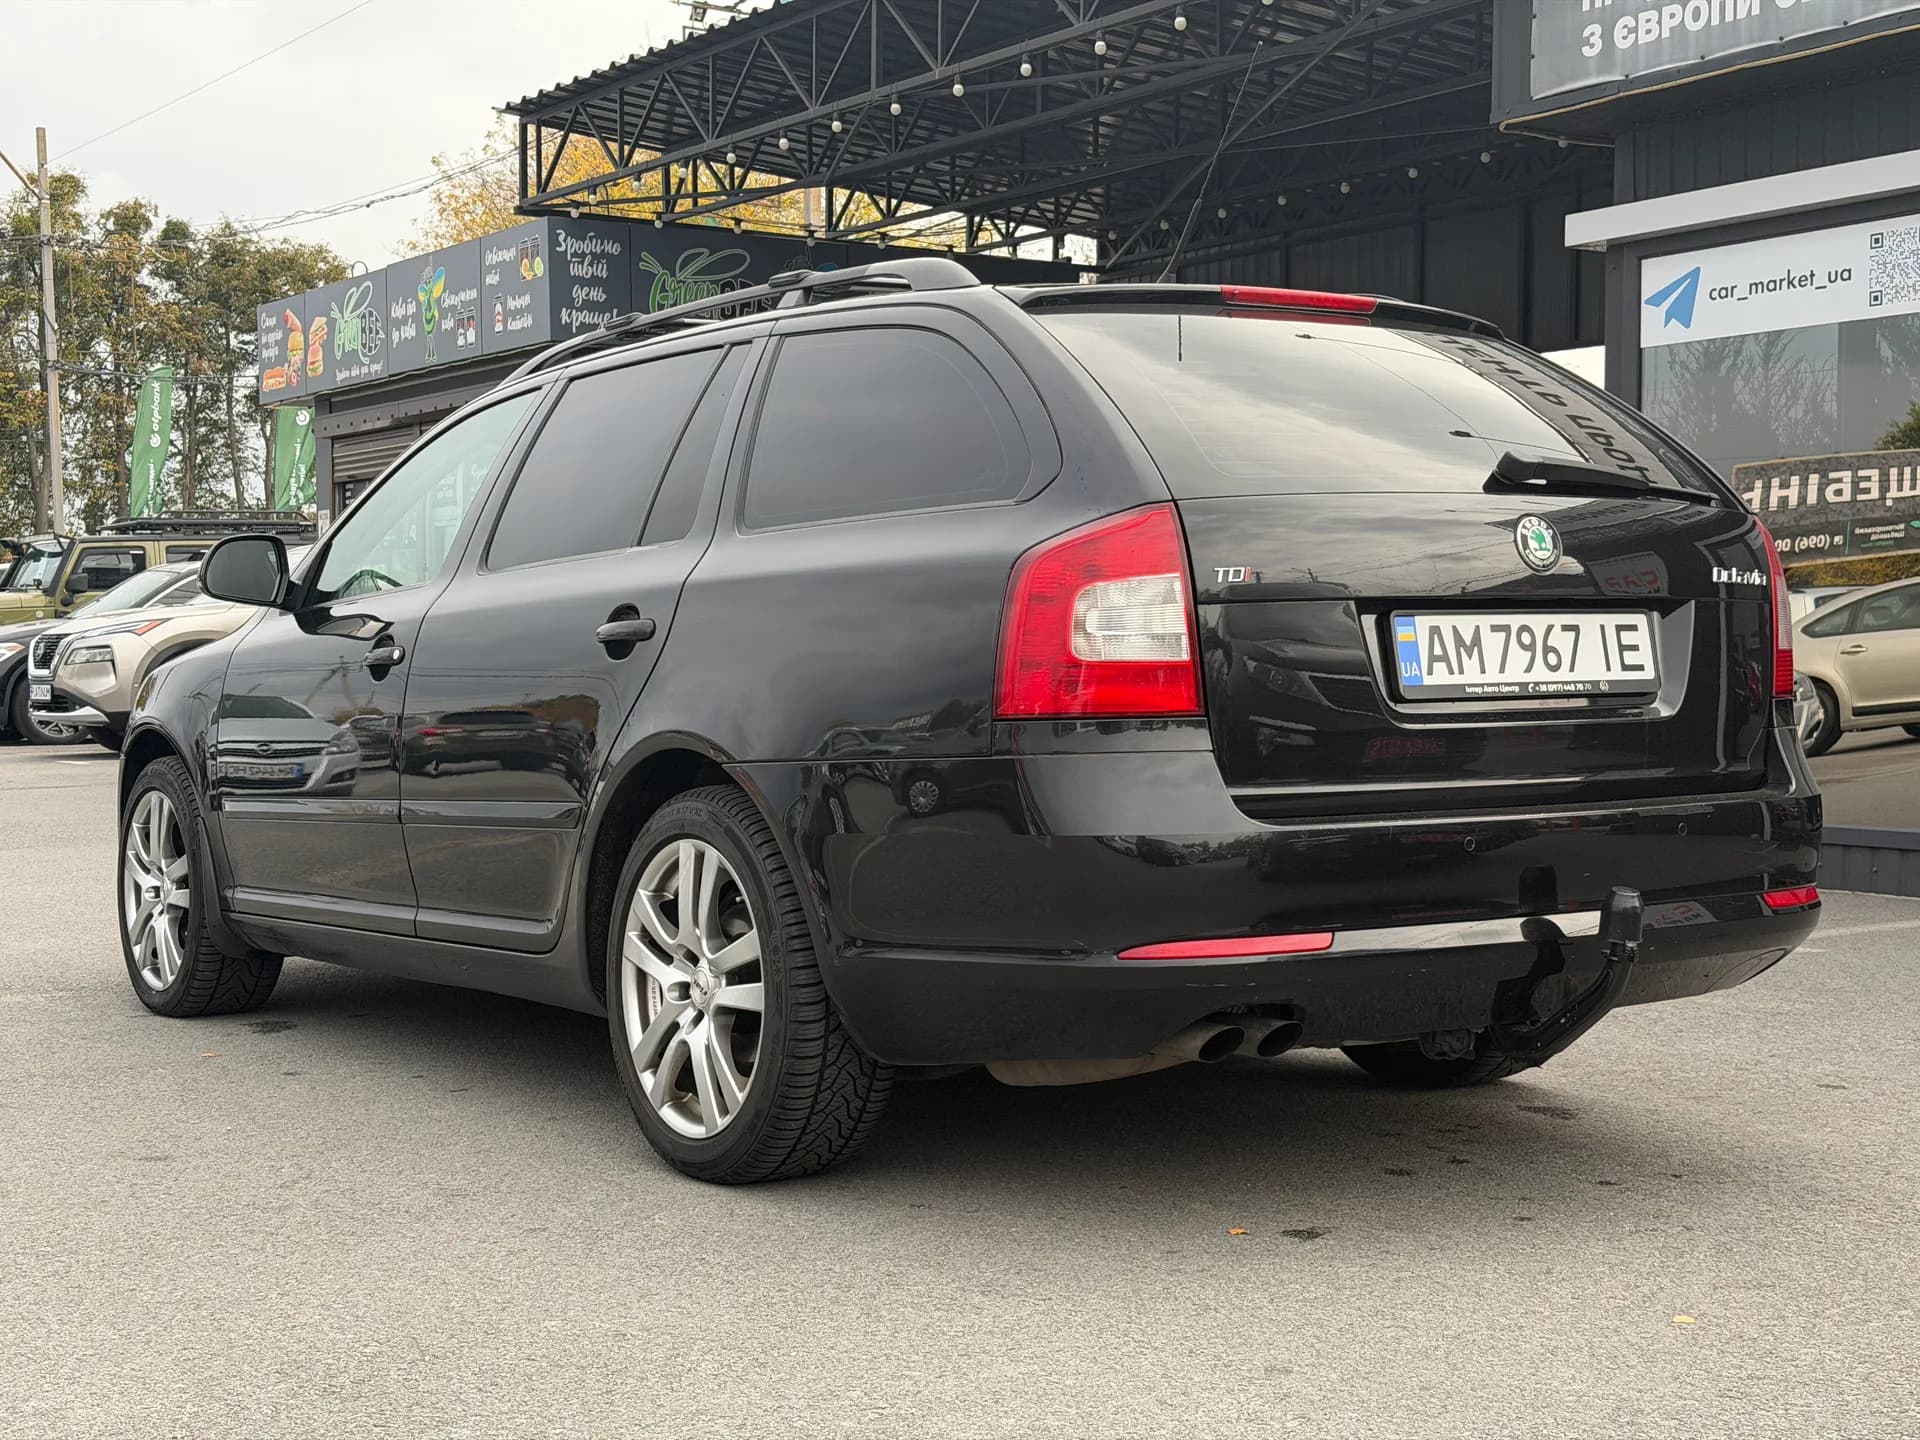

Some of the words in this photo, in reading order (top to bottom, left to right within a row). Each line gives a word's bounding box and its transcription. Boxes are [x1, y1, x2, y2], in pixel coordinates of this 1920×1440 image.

[1581, 24, 1603, 57] З
[1613, 0, 1760, 50] ЄВРОПИ
[556, 229, 621, 260] Зробимо
[569, 258, 608, 279] твій
[572, 284, 607, 307] день
[1708, 266, 1852, 302] car_market_ua
[1213, 566, 1251, 583] TDI
[1600, 623, 1645, 672] IE
[1402, 661, 1421, 677] UA
